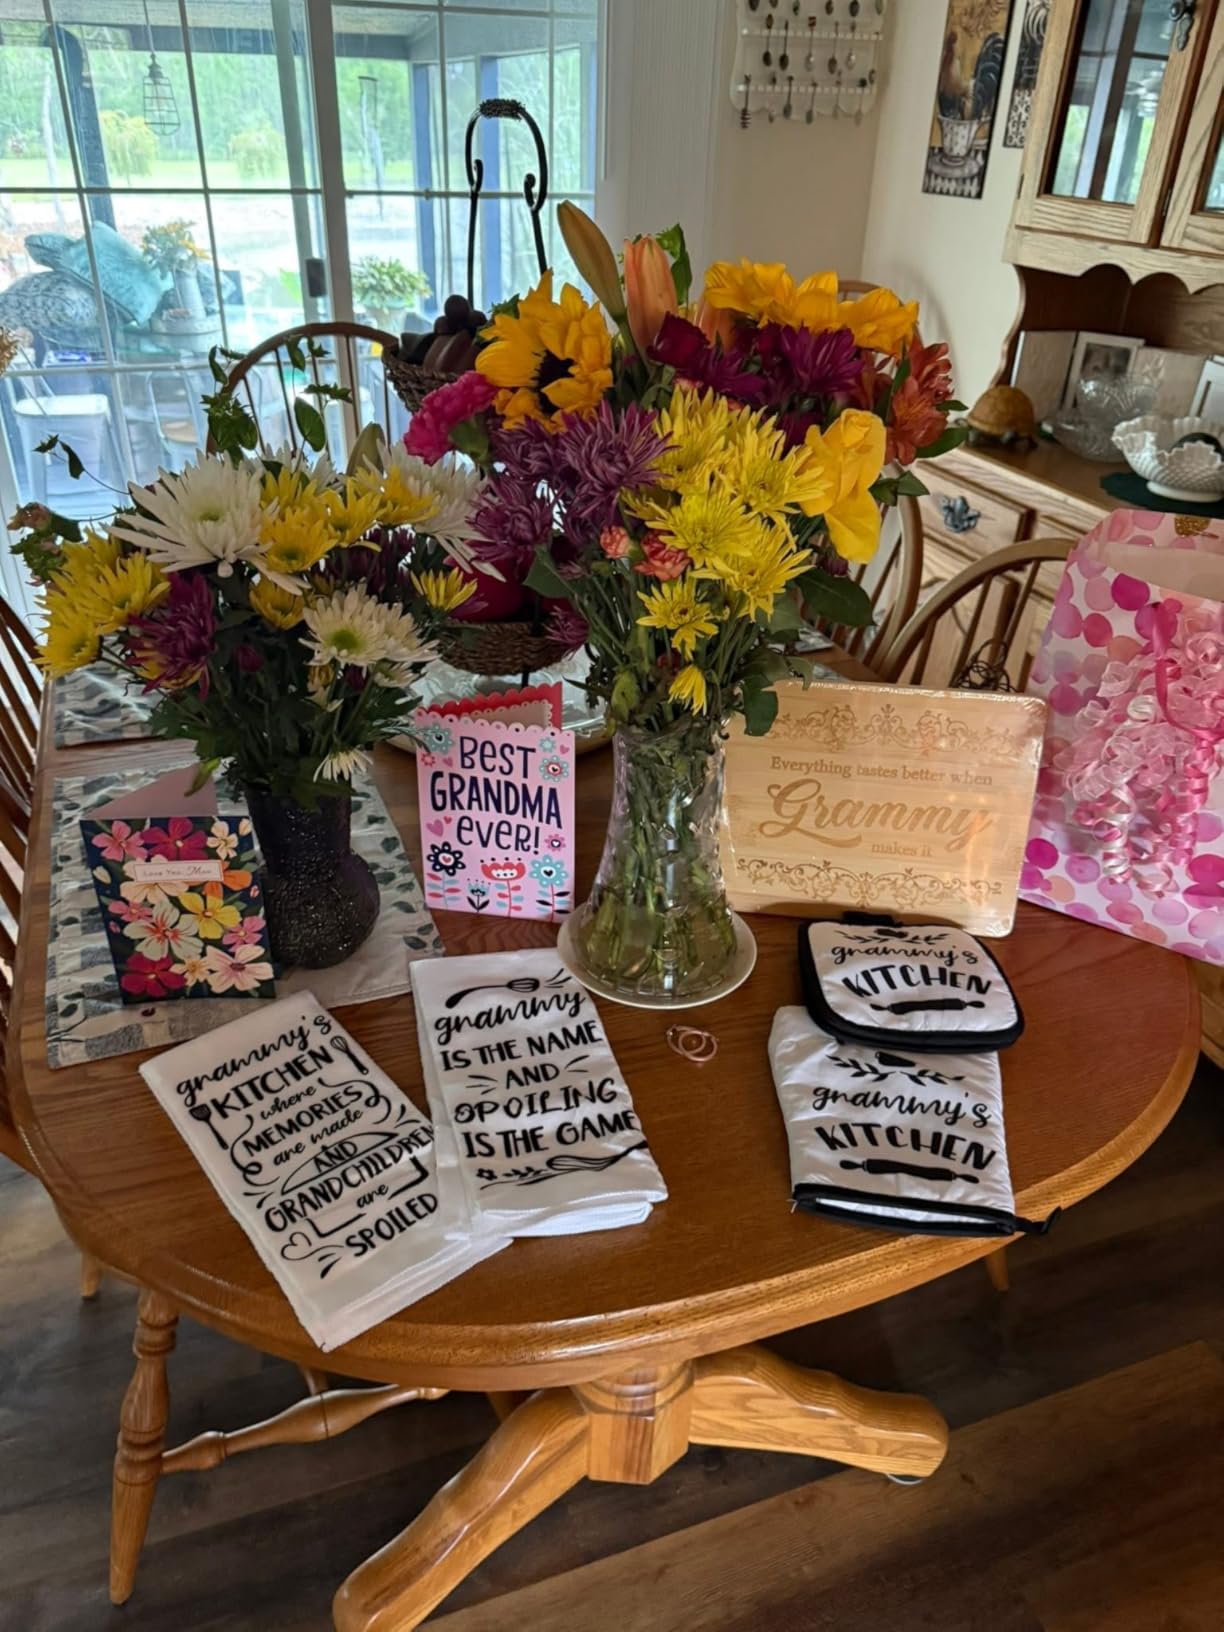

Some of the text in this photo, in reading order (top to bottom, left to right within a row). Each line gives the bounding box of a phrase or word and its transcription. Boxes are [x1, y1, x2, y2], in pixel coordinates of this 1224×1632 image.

[770, 756, 993, 786] Everything tastes better when
[430, 771, 563, 829] GRANDMA
[759, 778, 993, 851] Grammy
[871, 841, 932, 858] makes it
[831, 945, 978, 966] grammy's
[841, 964, 992, 998] KITCHEN
[434, 991, 586, 1046] grammy
[176, 1014, 332, 1107] grammy's
[440, 1020, 603, 1071] IS THE NAME
[211, 1046, 334, 1119] KITCHEN
[505, 1063, 560, 1090] AND
[242, 1085, 363, 1157] MEMORIES
[260, 1083, 317, 1120] where
[812, 1086, 991, 1128] grammy's
[273, 1109, 363, 1166] are made
[313, 1140, 358, 1172] AND
[462, 1110, 641, 1158] IS THE GAME
[814, 1122, 996, 1170] KITCHEN
[356, 1184, 389, 1208] are
[345, 1192, 438, 1257] SPOILED
